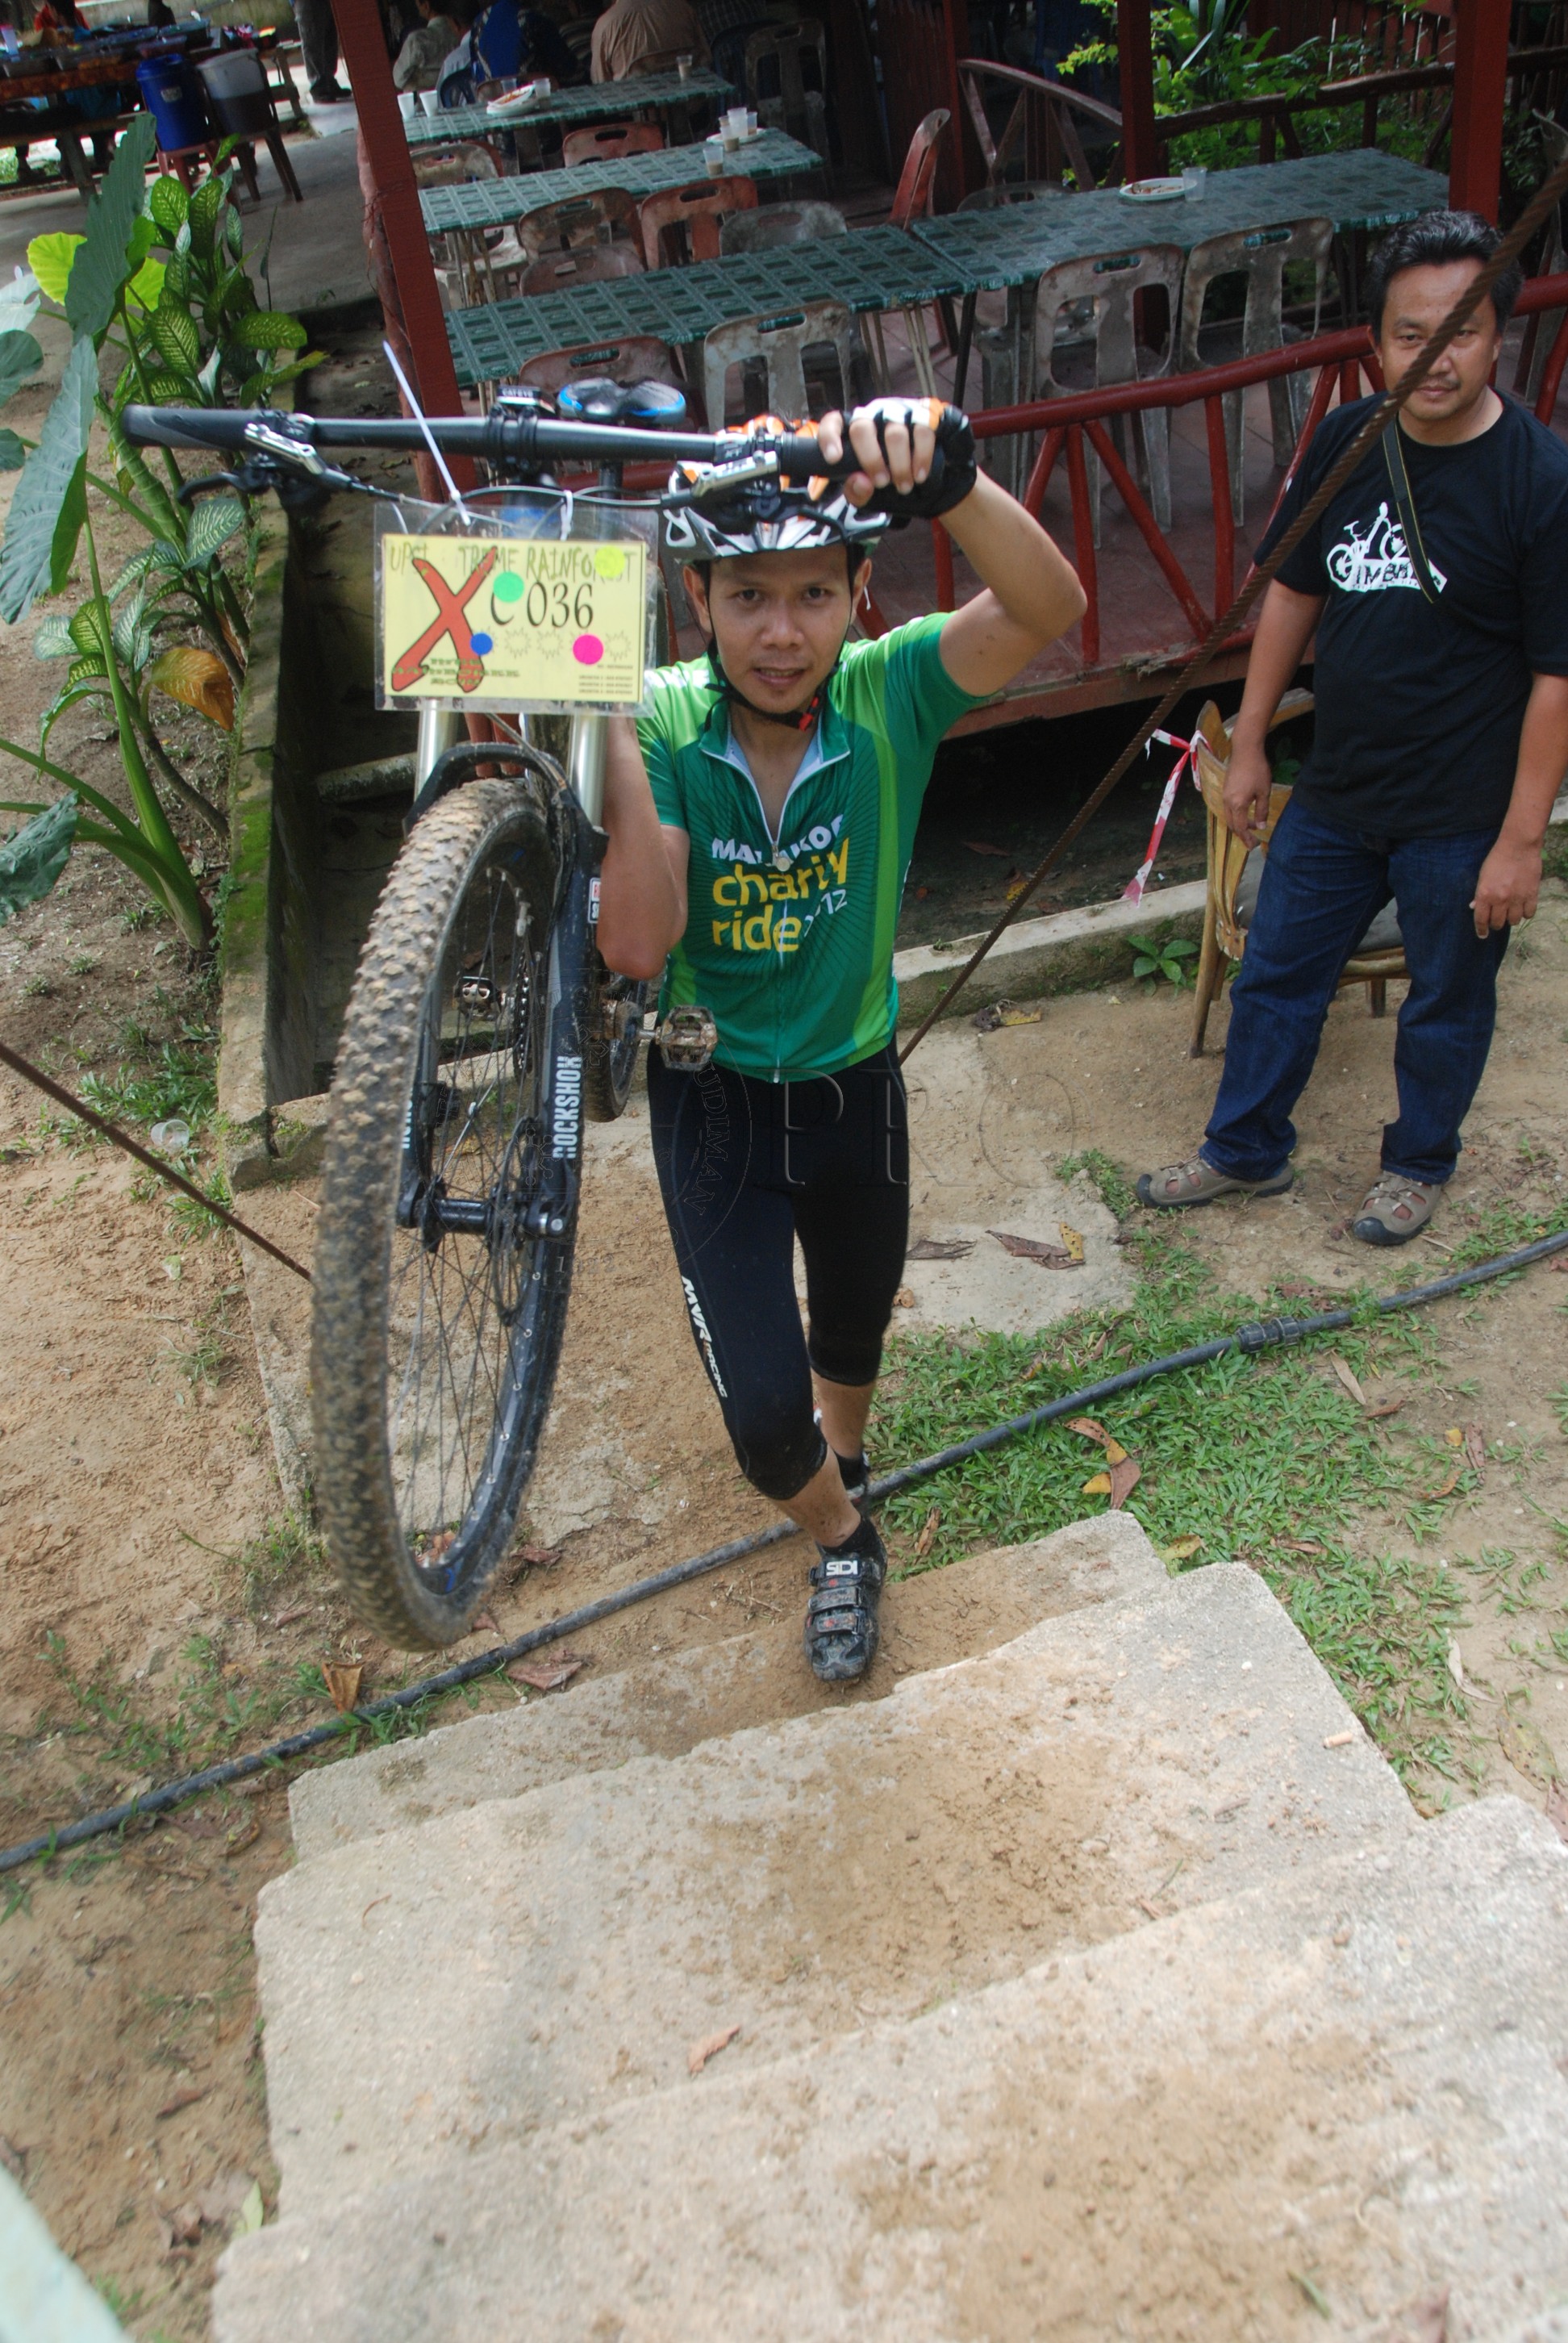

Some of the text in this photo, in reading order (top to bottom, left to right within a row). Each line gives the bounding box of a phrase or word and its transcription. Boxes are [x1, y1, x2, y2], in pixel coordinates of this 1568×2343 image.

[526, 546, 638, 583] RAINFOT
[526, 581, 595, 629] 036
[712, 837, 850, 906] chariy
[711, 904, 803, 953] ride
[825, 1560, 858, 1576] SIDI
